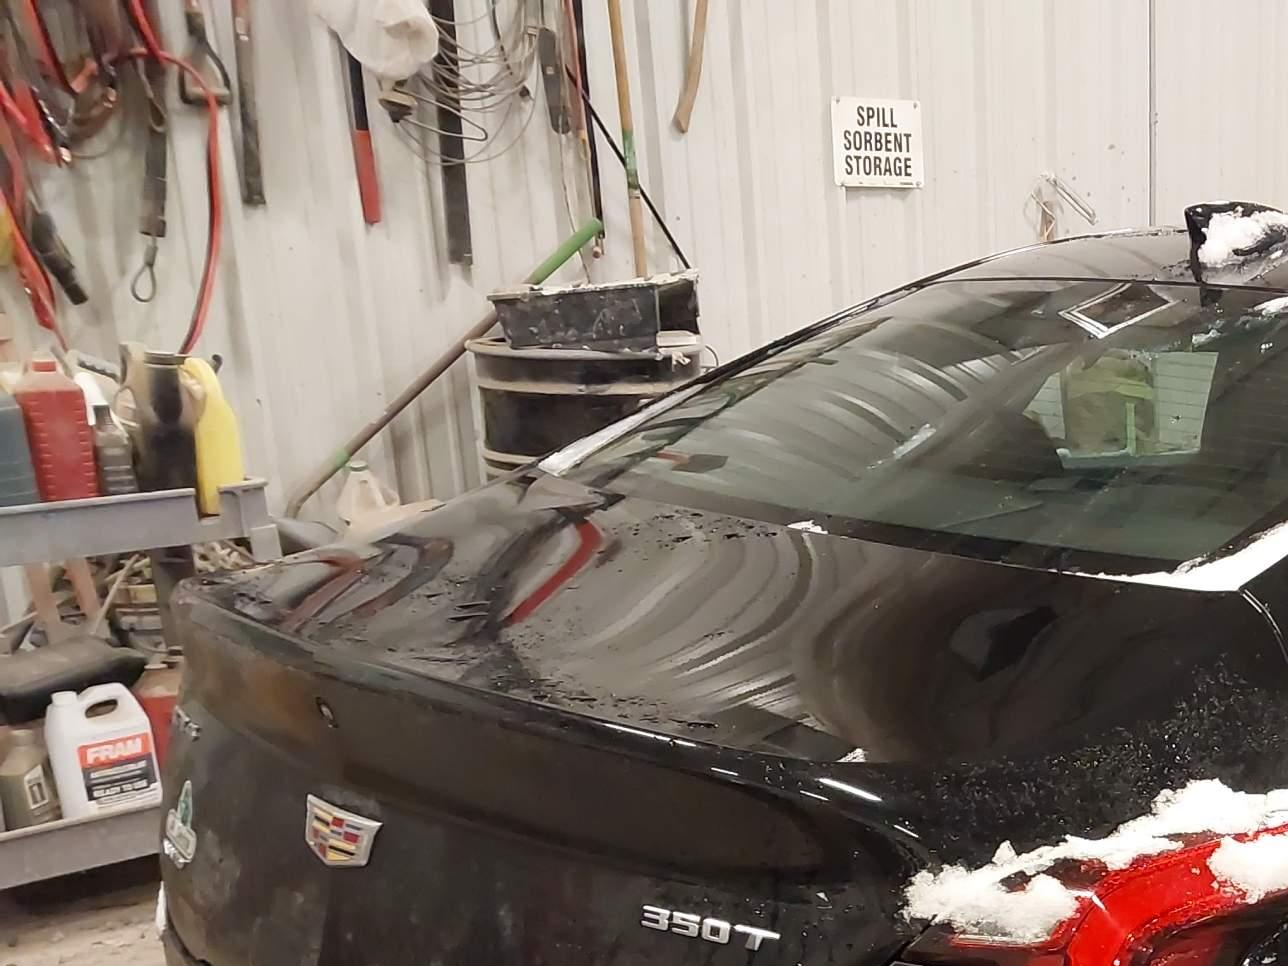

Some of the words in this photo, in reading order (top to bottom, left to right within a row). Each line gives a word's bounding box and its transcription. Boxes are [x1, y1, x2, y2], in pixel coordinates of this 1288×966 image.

[856, 105, 898, 128] SPILL
[843, 129, 912, 153] SORBENT
[845, 154, 912, 177] STORAGE
[86, 737, 143, 766] FRAM
